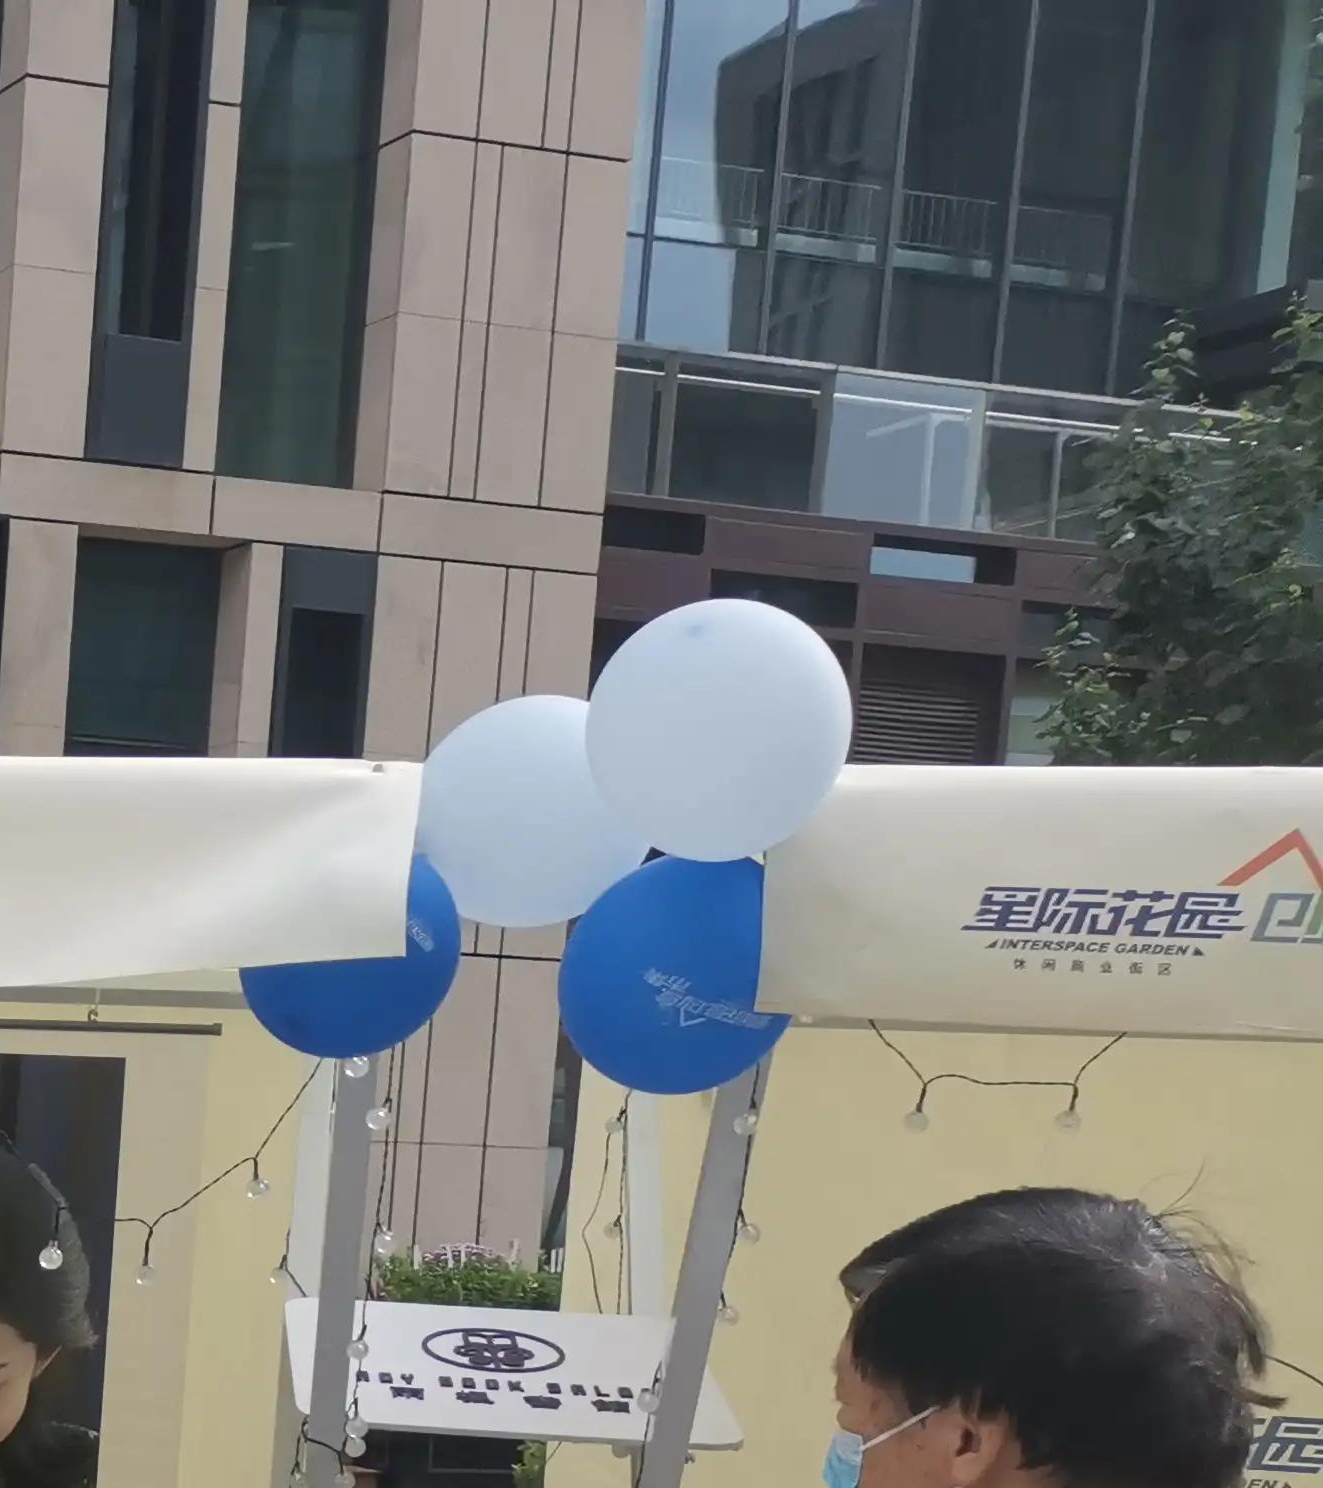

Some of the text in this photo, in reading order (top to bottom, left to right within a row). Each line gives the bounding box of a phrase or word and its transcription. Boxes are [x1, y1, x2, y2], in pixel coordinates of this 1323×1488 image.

[960, 886, 1248, 940] 星际花园
[999, 938, 1189, 957] INTERSPACE GARDEN
